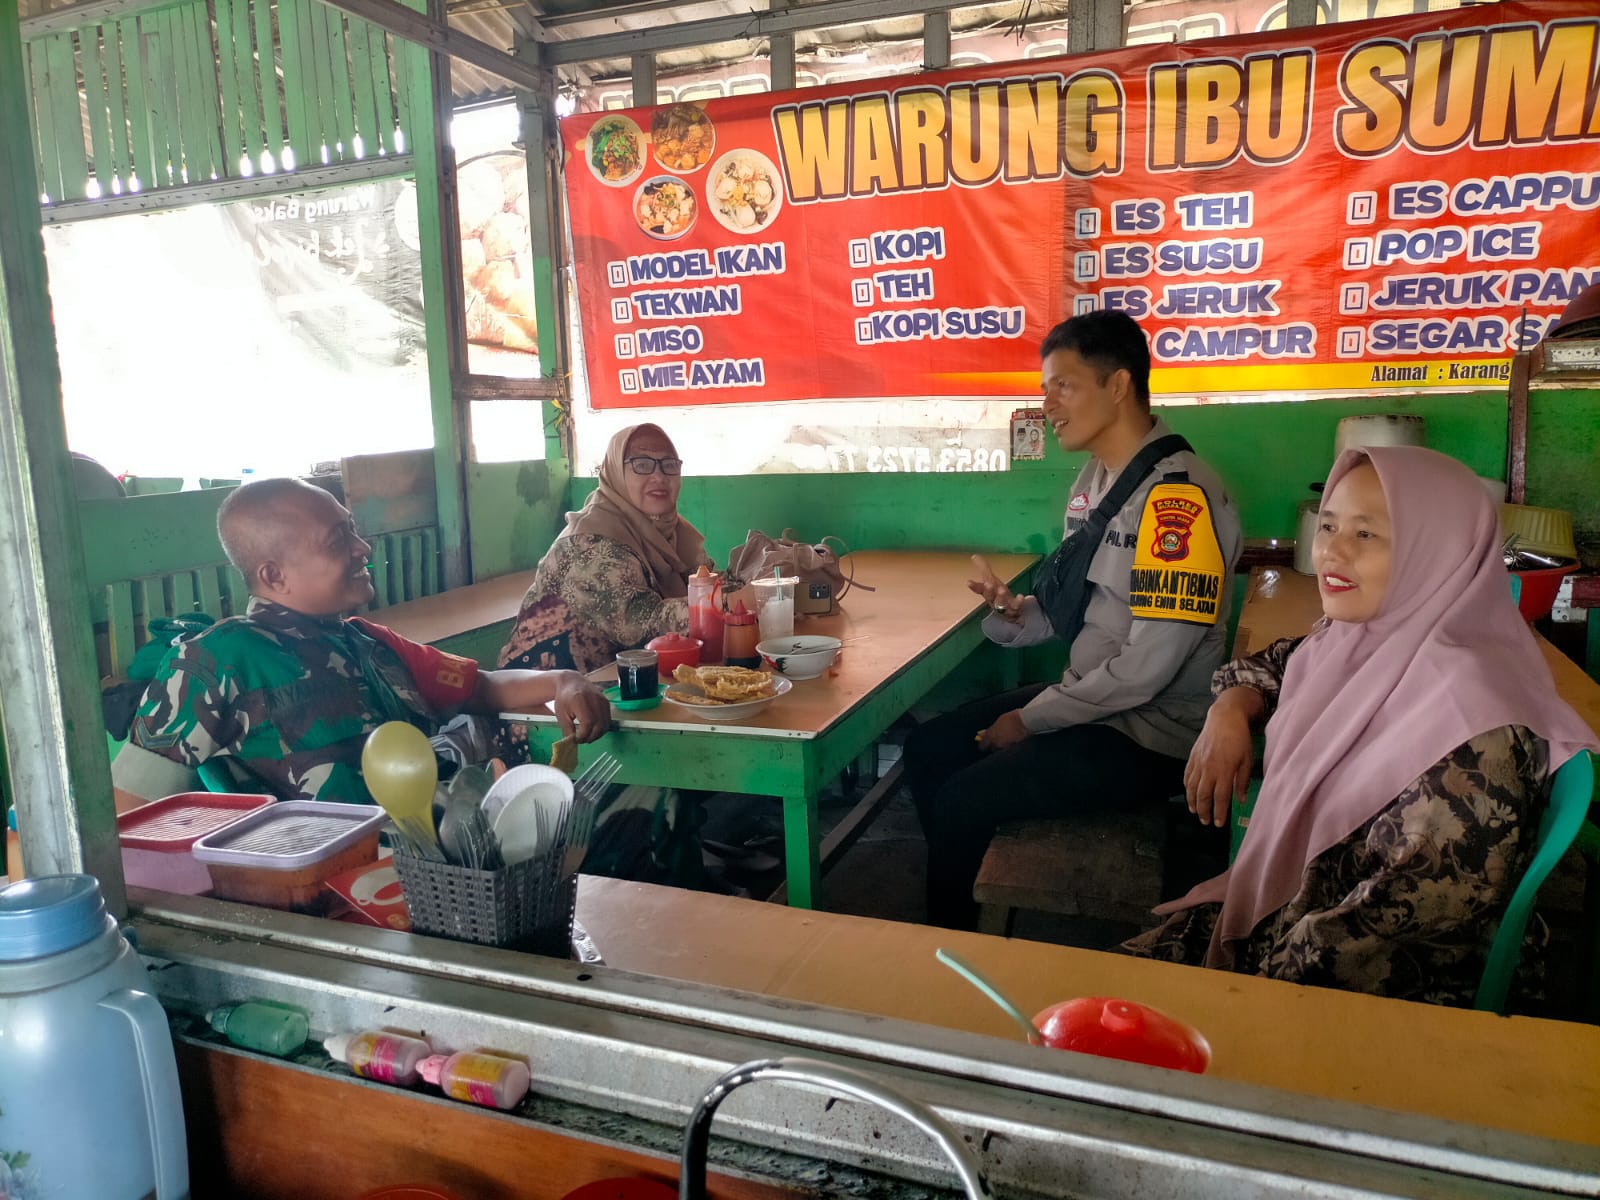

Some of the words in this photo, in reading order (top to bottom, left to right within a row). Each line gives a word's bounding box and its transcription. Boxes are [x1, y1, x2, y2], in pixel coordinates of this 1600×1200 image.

[772, 72, 1124, 204] WARUNG
[1148, 49, 1315, 172] IBU
[1336, 18, 1600, 158] SUM
[1115, 203, 1162, 231] ES
[1179, 195, 1250, 228] TEH
[1394, 184, 1444, 215] ES
[873, 230, 943, 261] KOPI
[1104, 246, 1149, 276] ES
[1159, 241, 1260, 271] SUSU
[1379, 230, 1464, 262] POP
[1472, 226, 1538, 257] ICE
[630, 251, 713, 282] MODEL
[717, 244, 783, 276] IKAN
[878, 270, 932, 300] TEH
[1103, 289, 1148, 317] ES
[1156, 284, 1278, 316] JERUK
[1374, 274, 1505, 307] JERUK
[634, 287, 739, 317] TEKWAN
[639, 327, 701, 354] MISO
[873, 310, 941, 341] KOPI
[945, 309, 1023, 338] SUSU
[1371, 319, 1505, 351] SEGAR
[1512, 317, 1561, 347] S
[1155, 326, 1313, 359] CAMPUR
[642, 365, 685, 390] MIE
[691, 361, 763, 387] AYAM
[1371, 364, 1428, 382] Alamat
[1447, 362, 1510, 381] Karang
[1179, 598, 1216, 616] SELATAN
